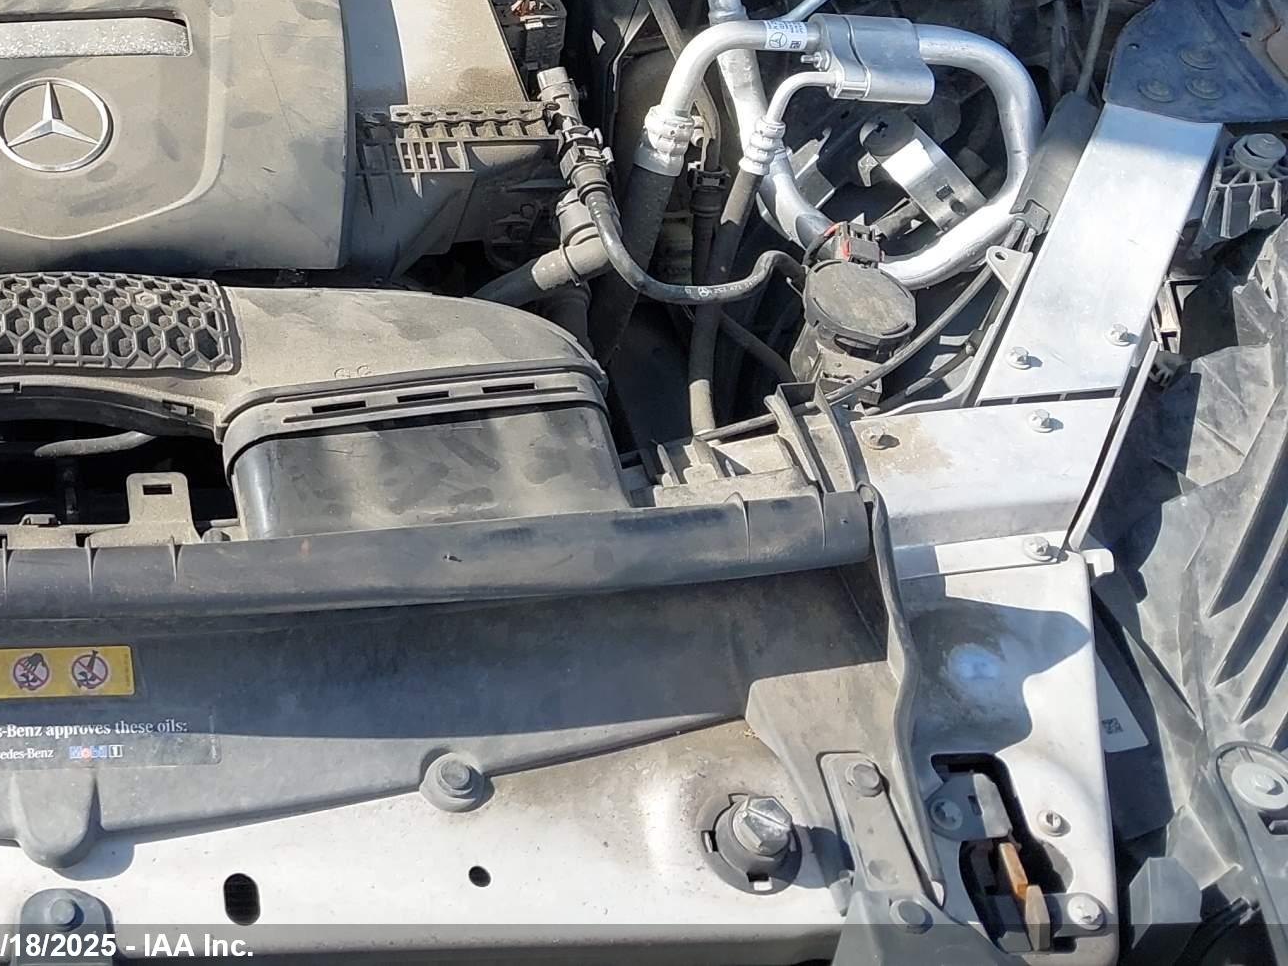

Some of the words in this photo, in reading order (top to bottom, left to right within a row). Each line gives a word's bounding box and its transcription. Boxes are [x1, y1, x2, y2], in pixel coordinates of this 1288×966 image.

[45, 723, 112, 740] approves
[114, 720, 154, 735] these
[157, 719, 188, 734] oils:
